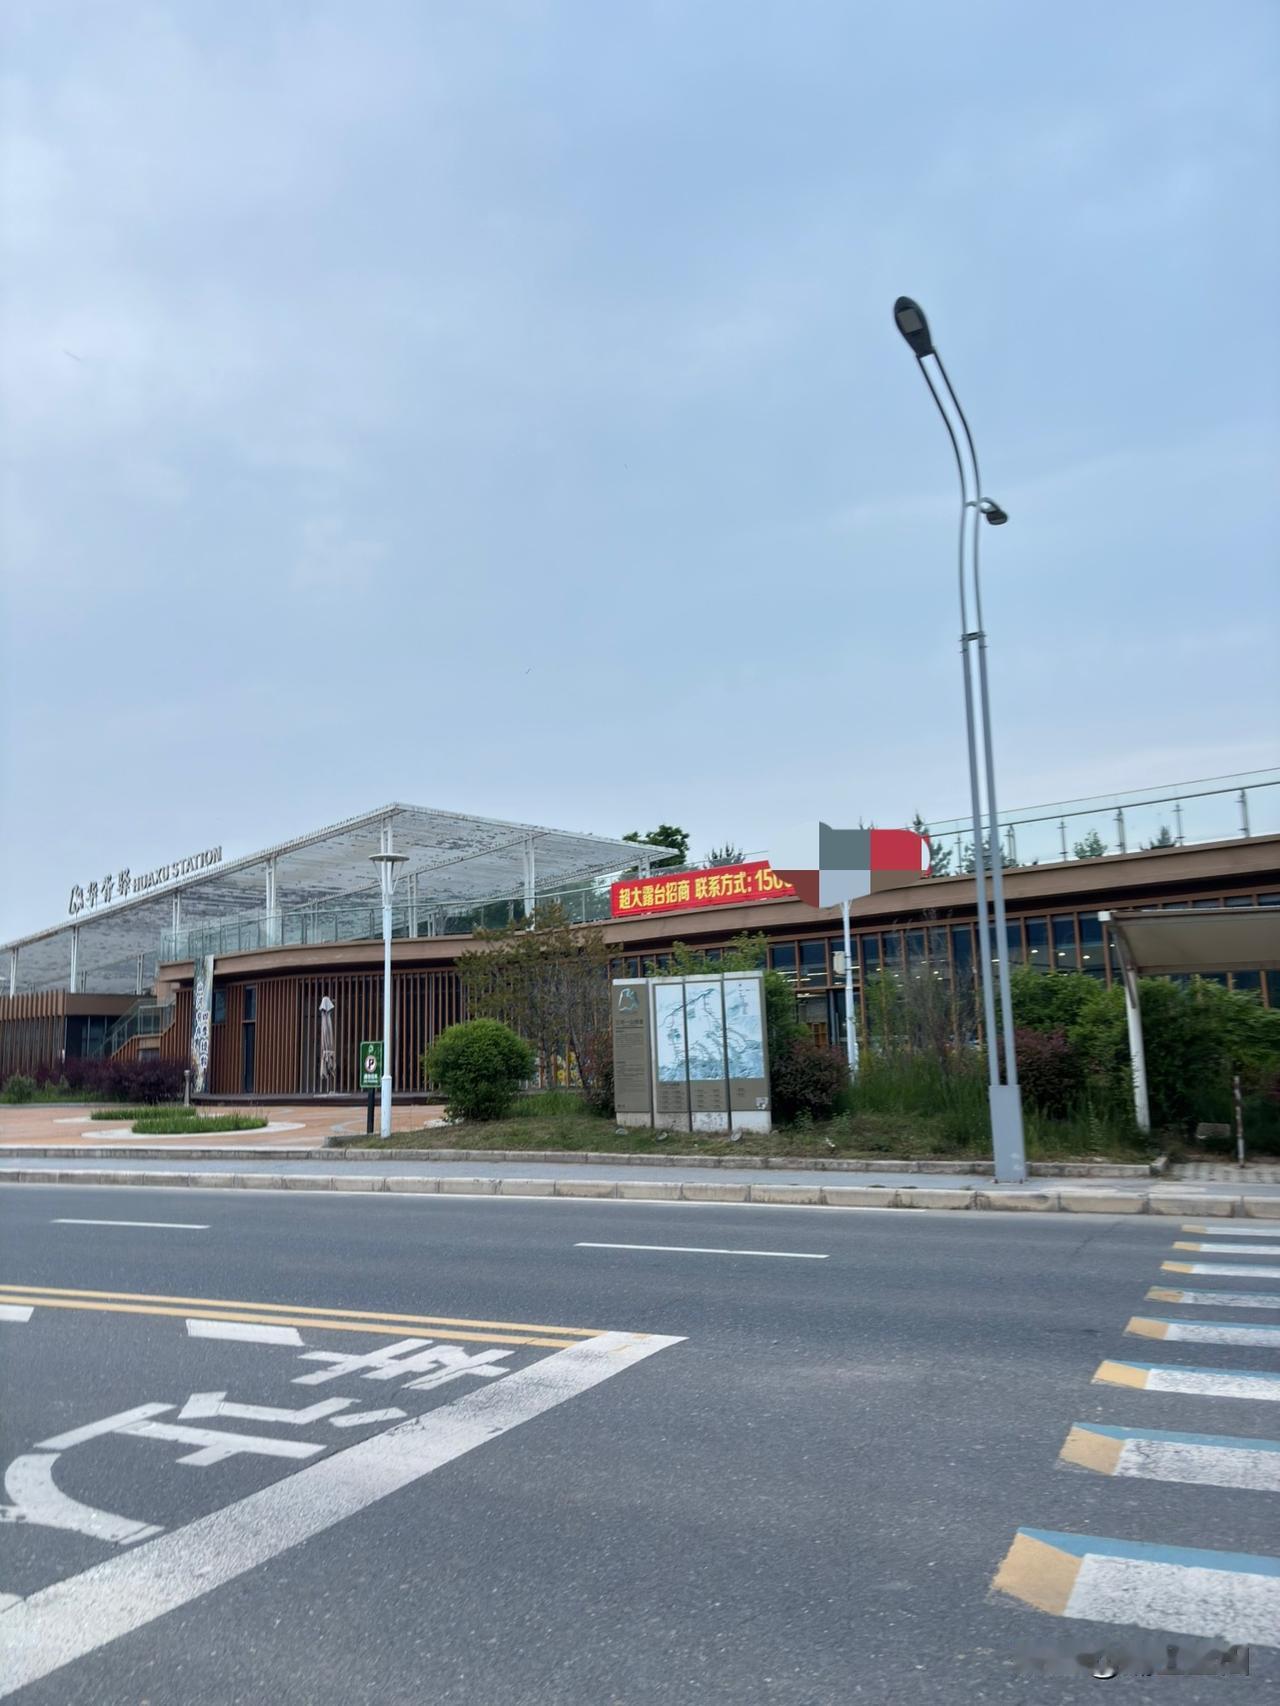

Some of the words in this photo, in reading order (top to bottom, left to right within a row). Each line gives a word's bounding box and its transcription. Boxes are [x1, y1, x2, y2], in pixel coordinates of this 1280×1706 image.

[133, 864, 169, 892] HUAXU
[171, 846, 222, 876] STATION
[618, 880, 690, 909] 超大露台招商
